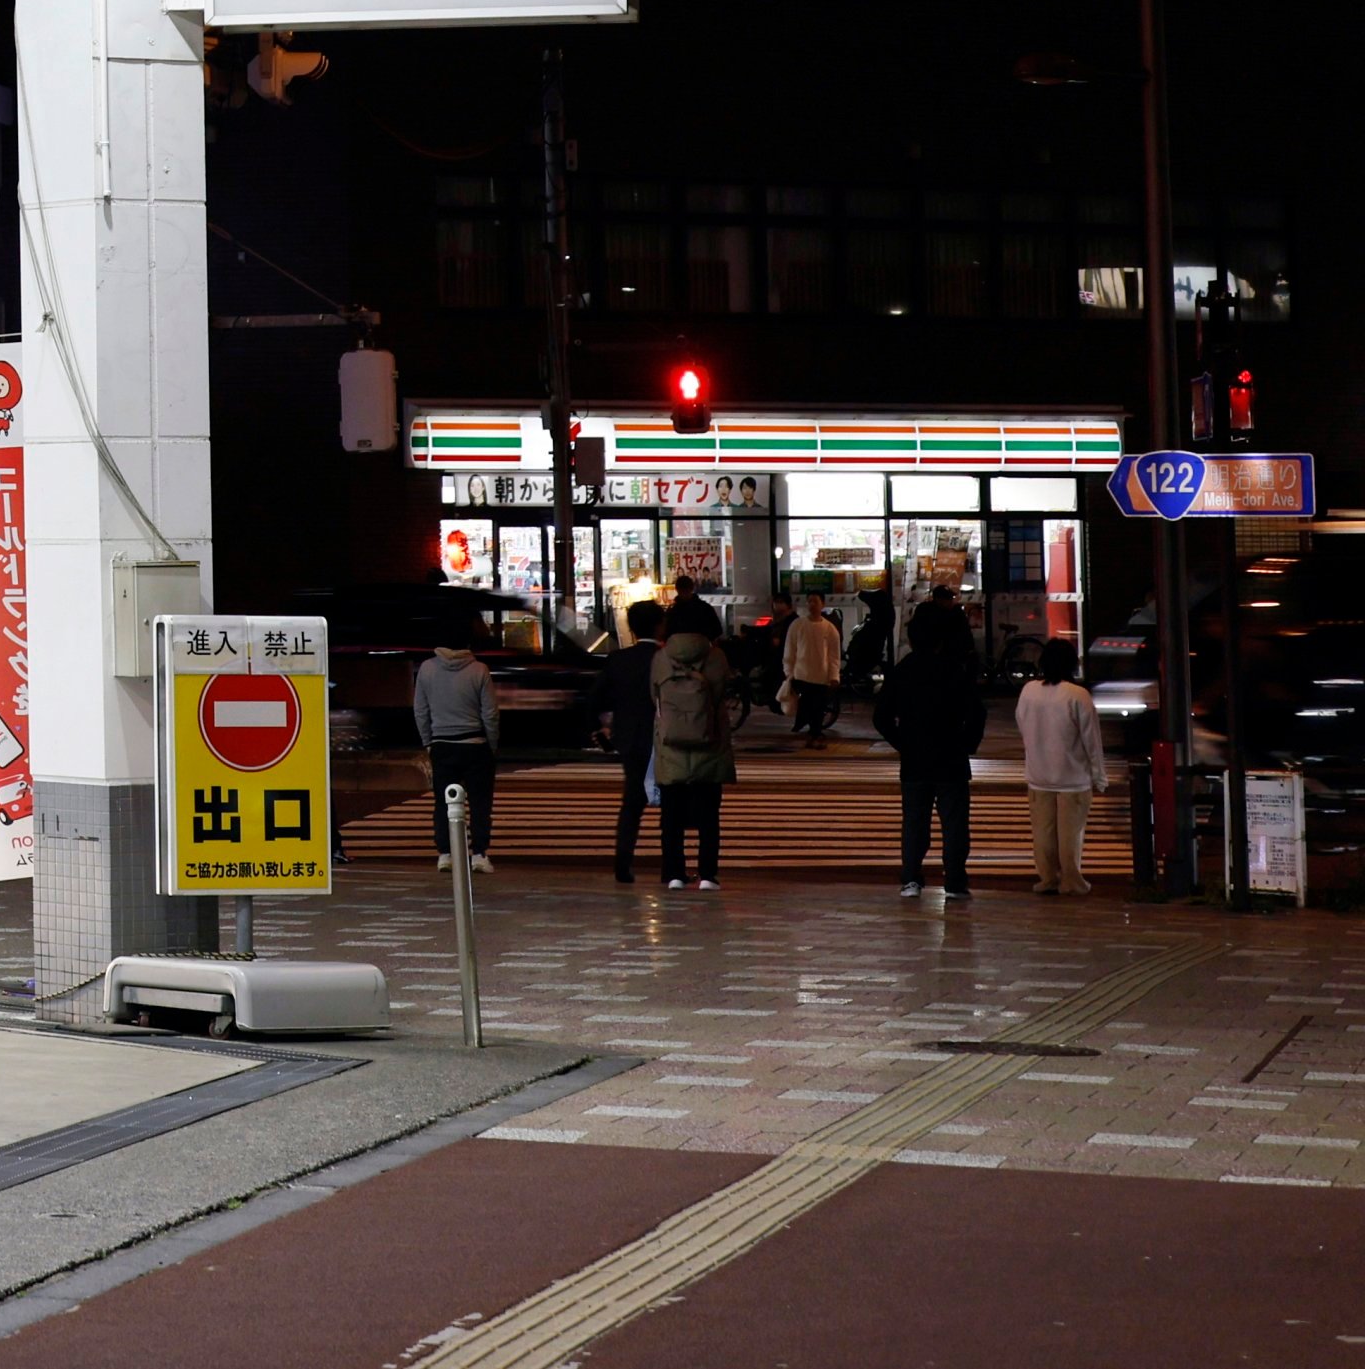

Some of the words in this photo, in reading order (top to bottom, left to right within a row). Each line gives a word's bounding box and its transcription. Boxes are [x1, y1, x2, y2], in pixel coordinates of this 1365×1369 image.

[1146, 462, 1195, 493] 122
[1211, 463, 1297, 491] 明治通り
[1204, 491, 1265, 509] Meiji-dori
[1272, 492, 1299, 508] Ave.
[193, 785, 312, 844] 出口
[185, 861, 324, 878] ご協力お願い致します。
